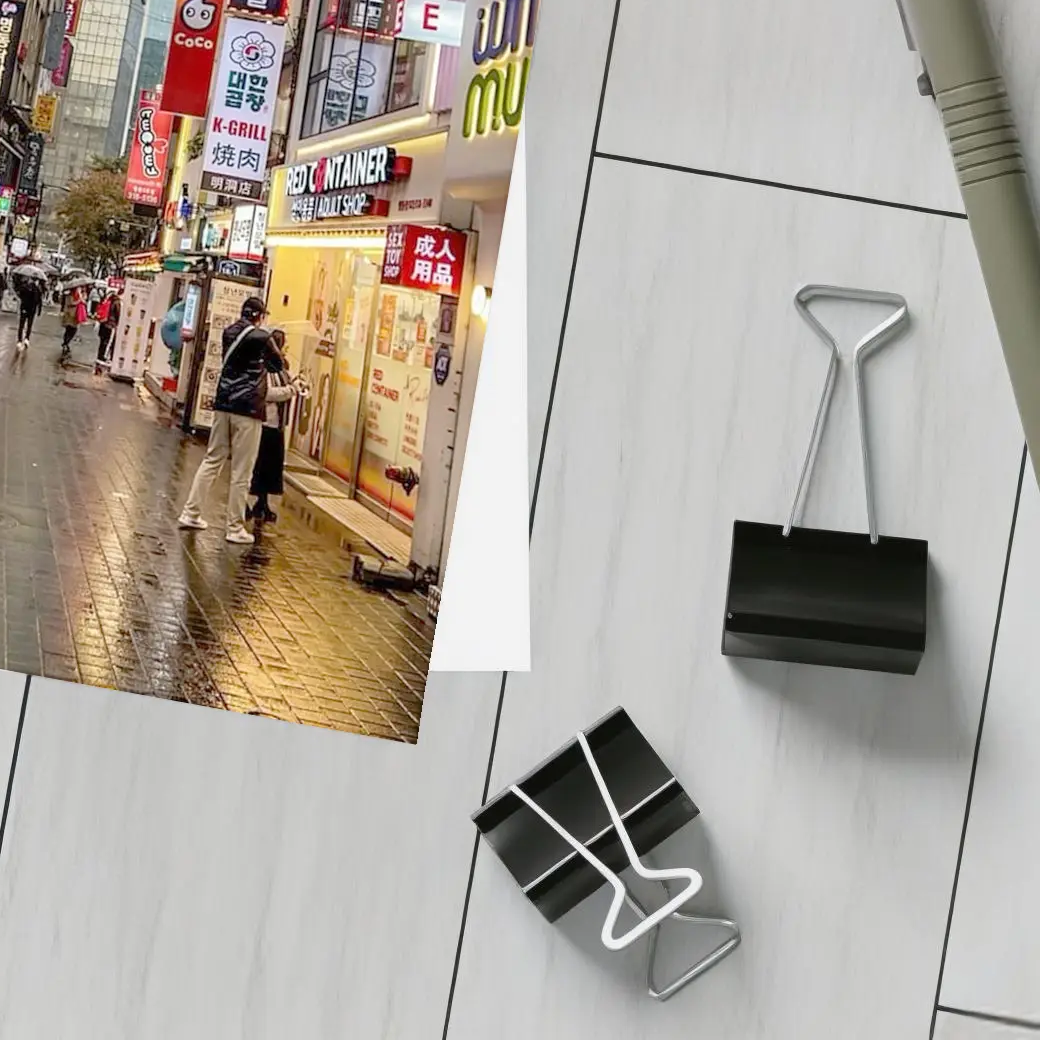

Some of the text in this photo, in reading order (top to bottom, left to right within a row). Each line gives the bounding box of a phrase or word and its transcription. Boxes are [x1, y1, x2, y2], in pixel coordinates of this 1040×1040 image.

[227, 70, 269, 94] 대한
[225, 89, 266, 112] 곱창
[212, 116, 267, 142] K-GRILL
[212, 141, 261, 172] 焼肉
[285, 146, 388, 196] RED CONTAINER
[210, 176, 253, 197] 明洞店
[317, 195, 343, 219] ADULT
[342, 192, 367, 217] SHOP
[387, 232, 403, 248] SEX
[414, 234, 456, 262] 成人
[386, 248, 402, 263] TOY
[411, 259, 454, 286] 用品
